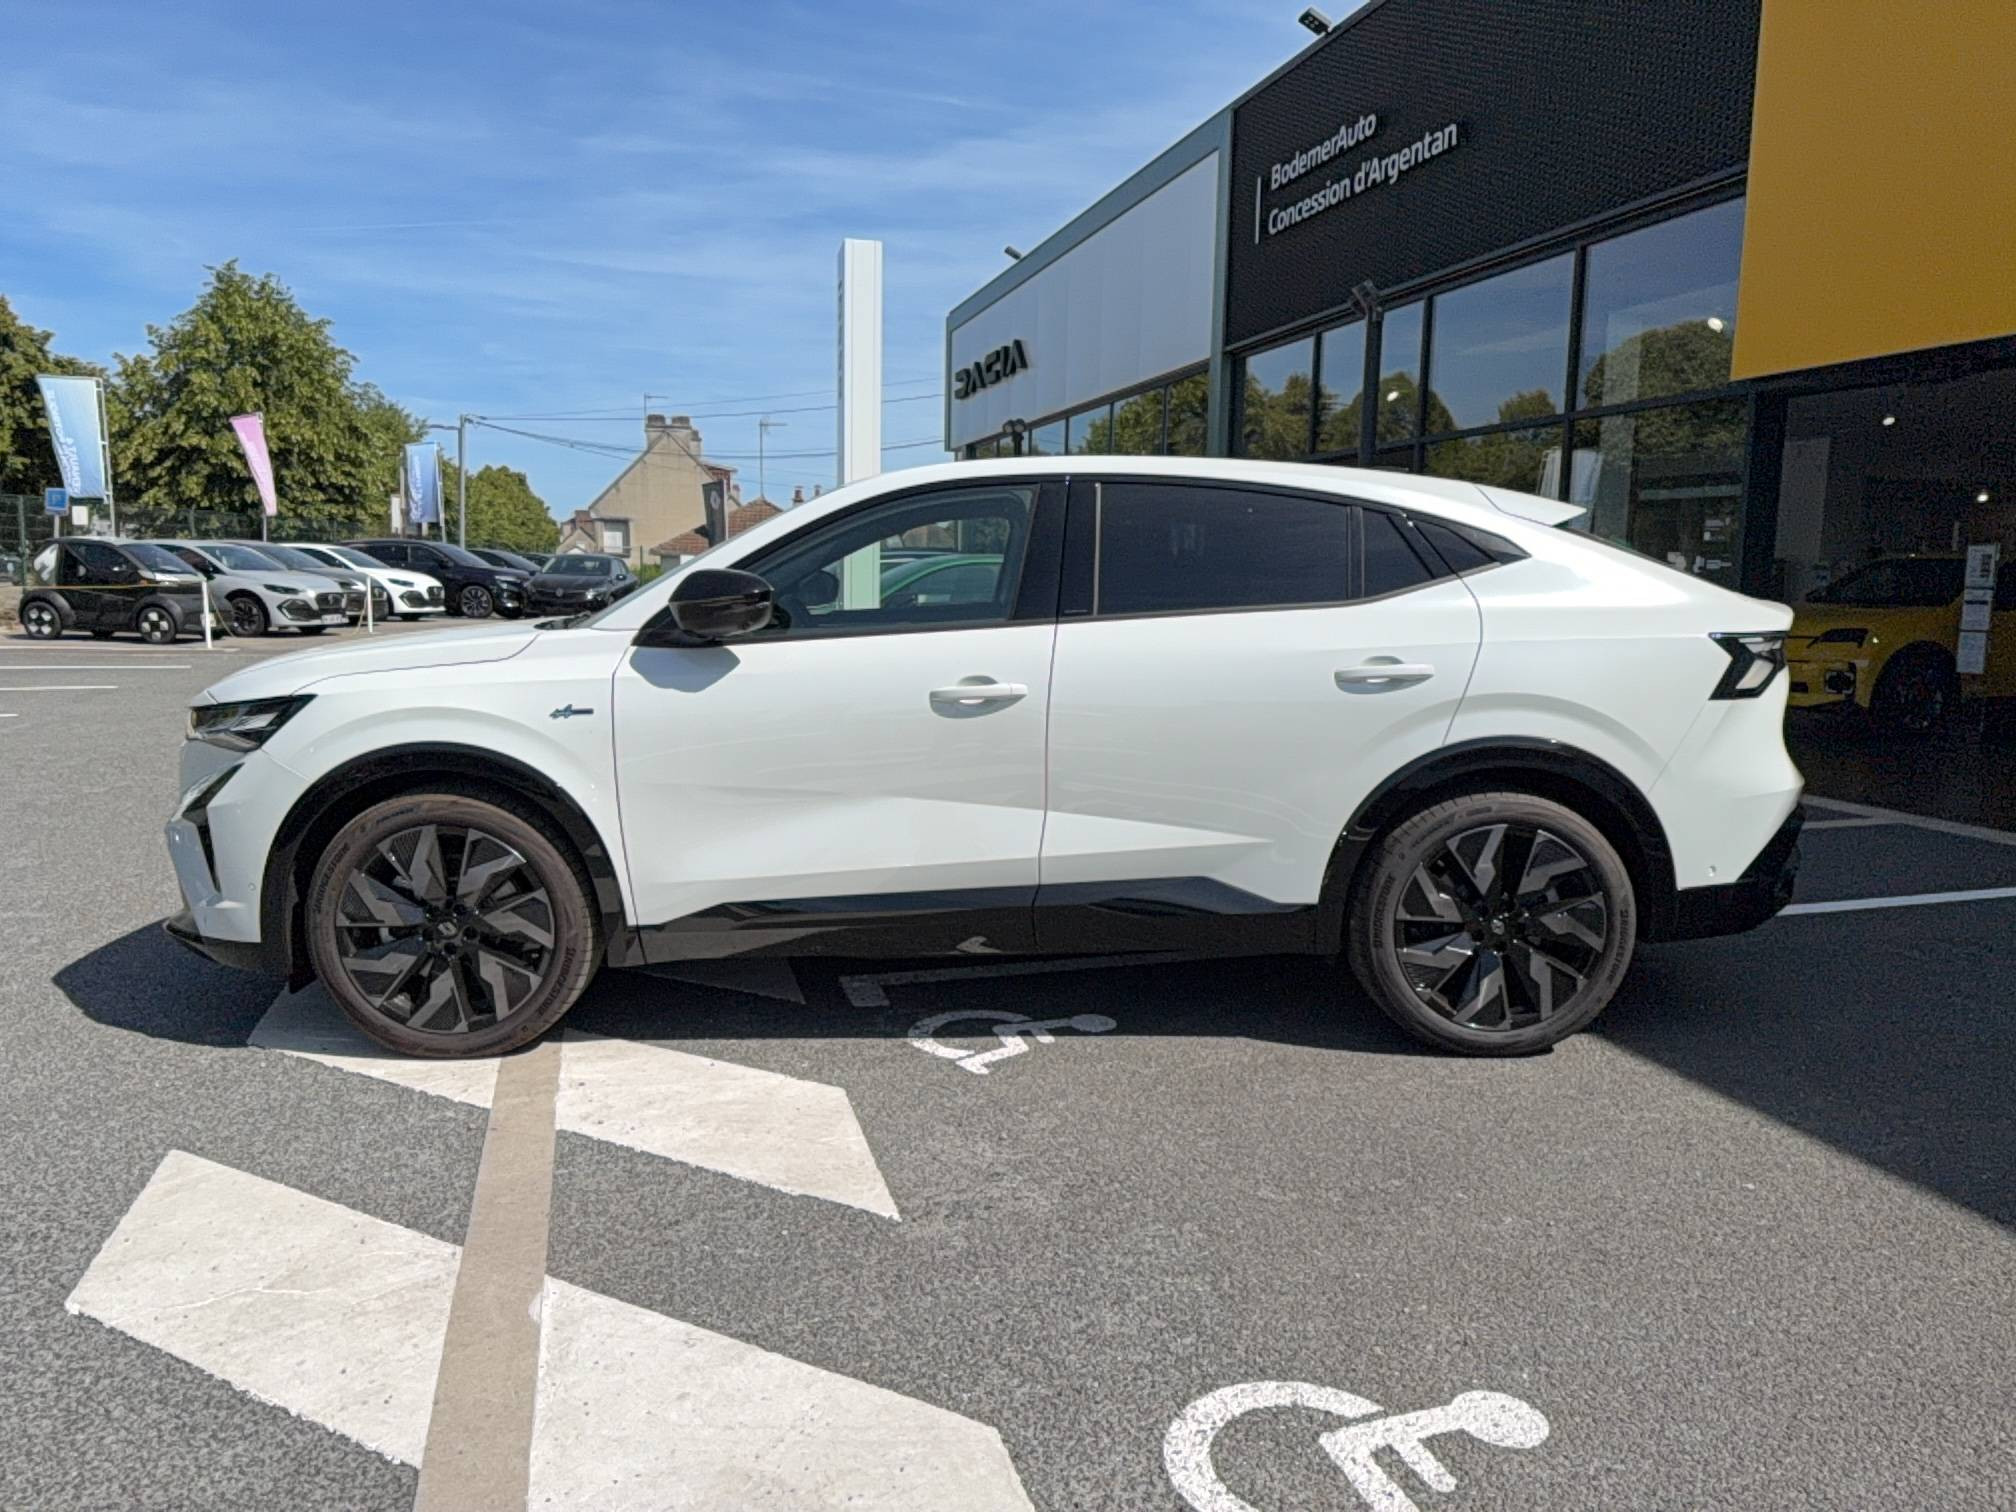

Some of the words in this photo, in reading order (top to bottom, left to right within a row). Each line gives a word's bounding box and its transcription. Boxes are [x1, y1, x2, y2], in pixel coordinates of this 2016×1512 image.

[1268, 180, 1350, 235] Concession
[1353, 123, 1458, 194] d'Argentan
[1270, 113, 1377, 191] BodemerAuto
[953, 338, 1029, 400] DACIA
